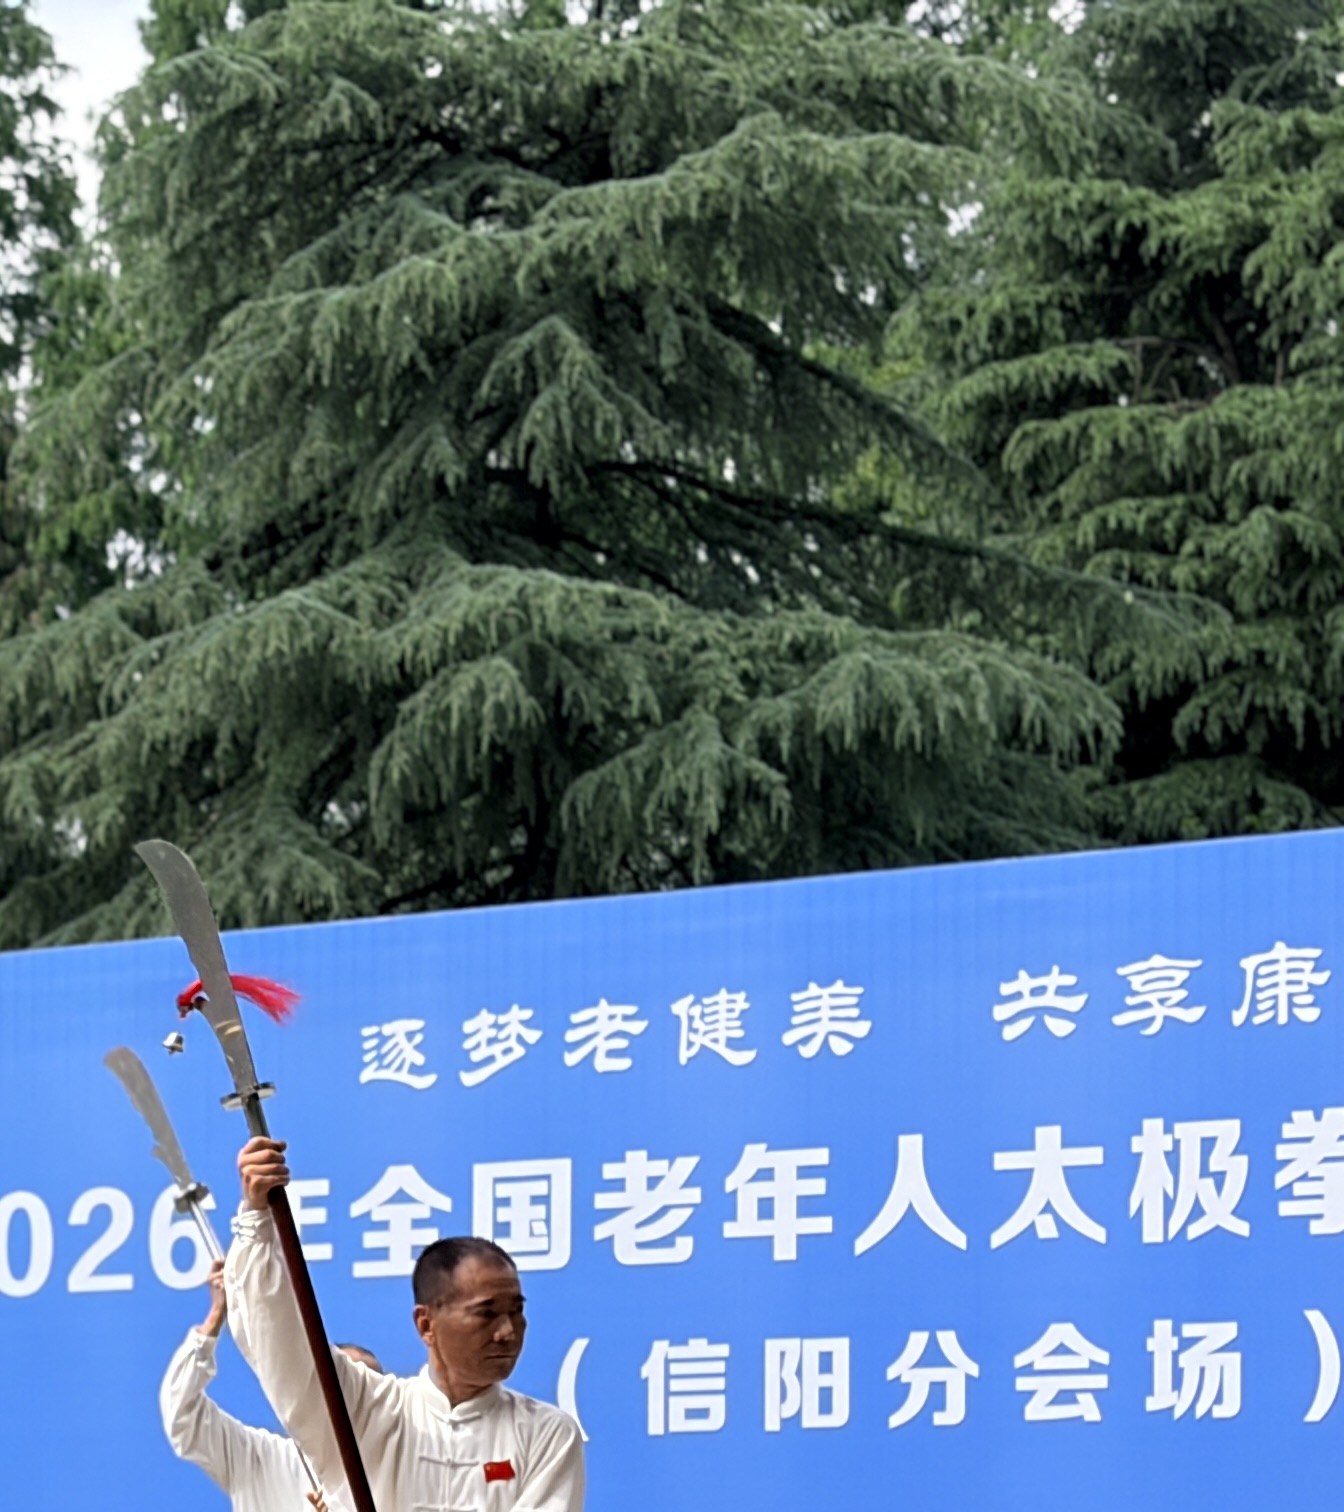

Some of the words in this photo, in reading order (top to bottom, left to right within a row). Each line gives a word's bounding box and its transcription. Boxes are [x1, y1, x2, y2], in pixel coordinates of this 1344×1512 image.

[359, 979, 872, 1089] 逐梦老健美
[992, 940, 1332, 1041] 共享康
